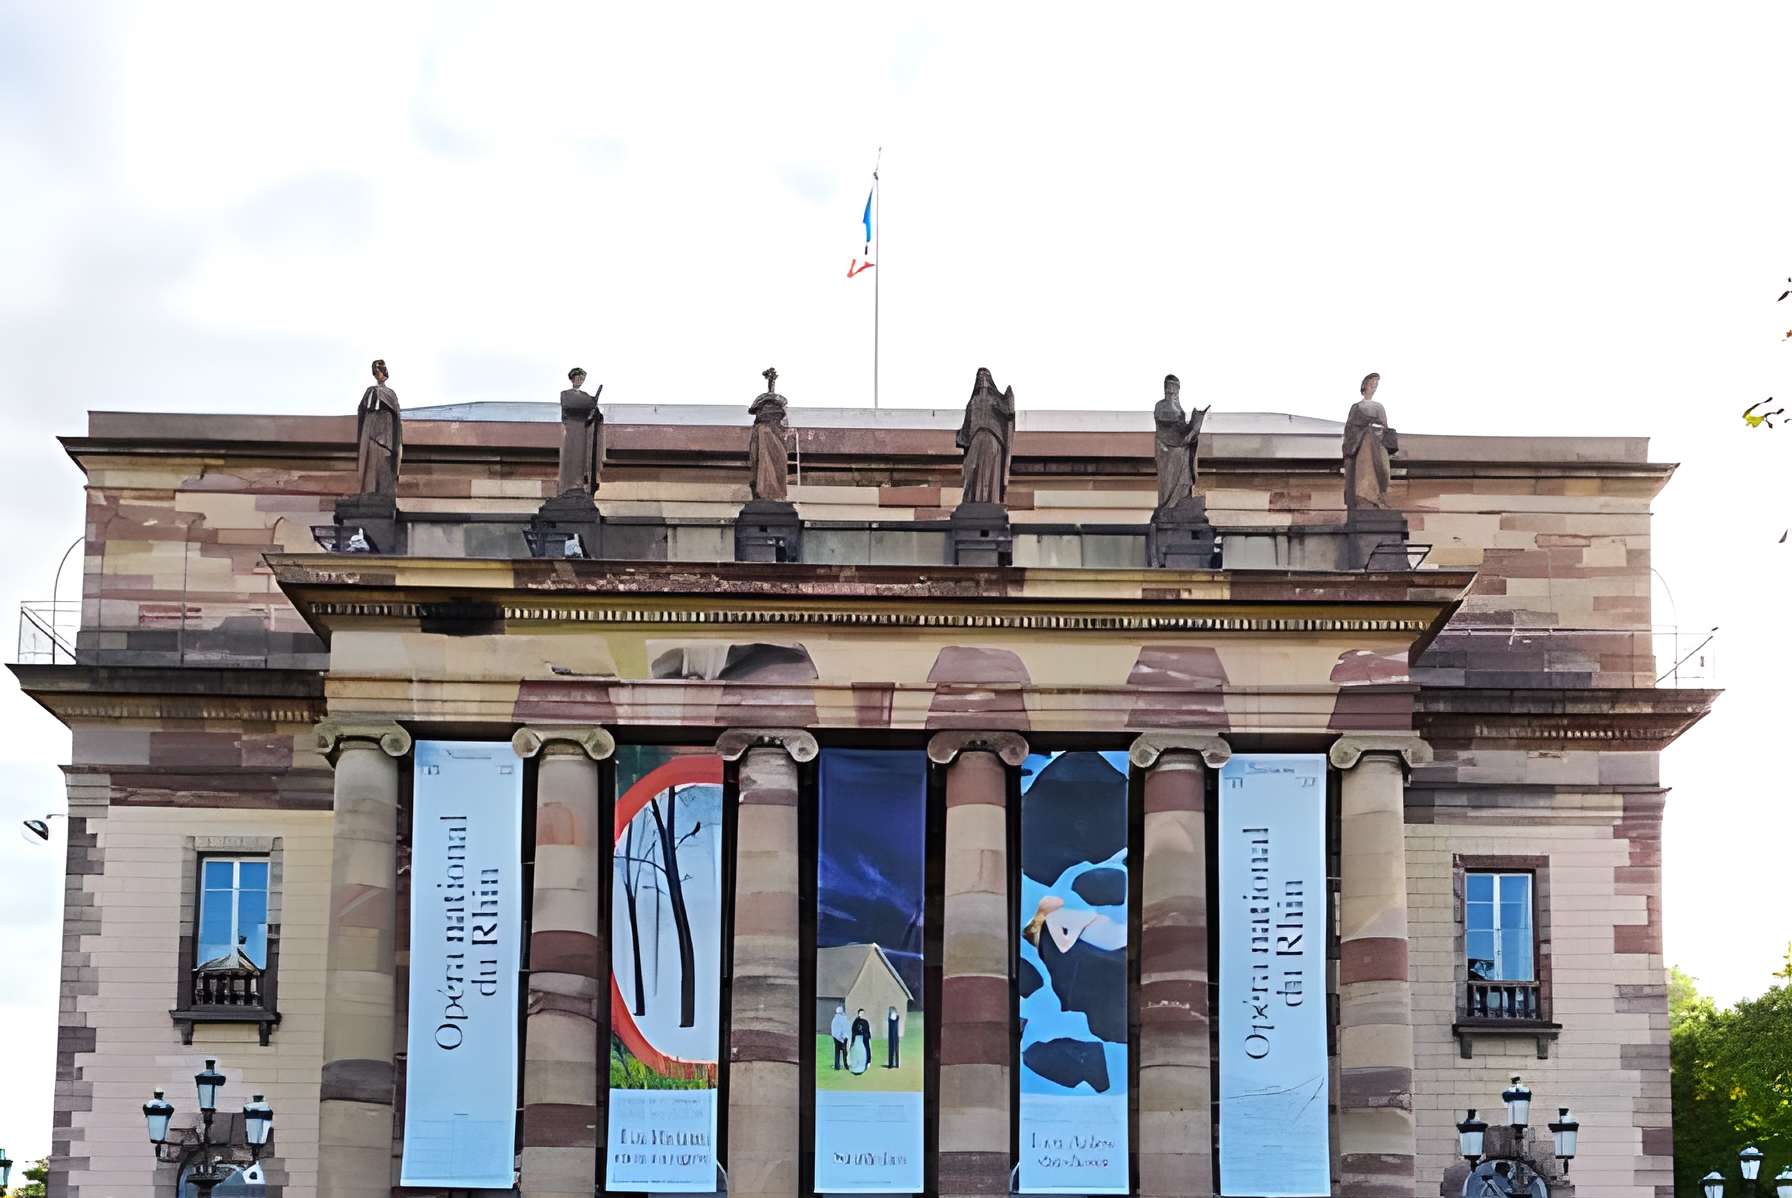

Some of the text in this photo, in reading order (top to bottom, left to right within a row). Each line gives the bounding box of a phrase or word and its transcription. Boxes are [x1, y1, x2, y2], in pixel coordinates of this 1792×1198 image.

[435, 816, 468, 1050] Opéra national
[470, 868, 499, 997] du Rhin
[1276, 880, 1303, 956] Rhin
